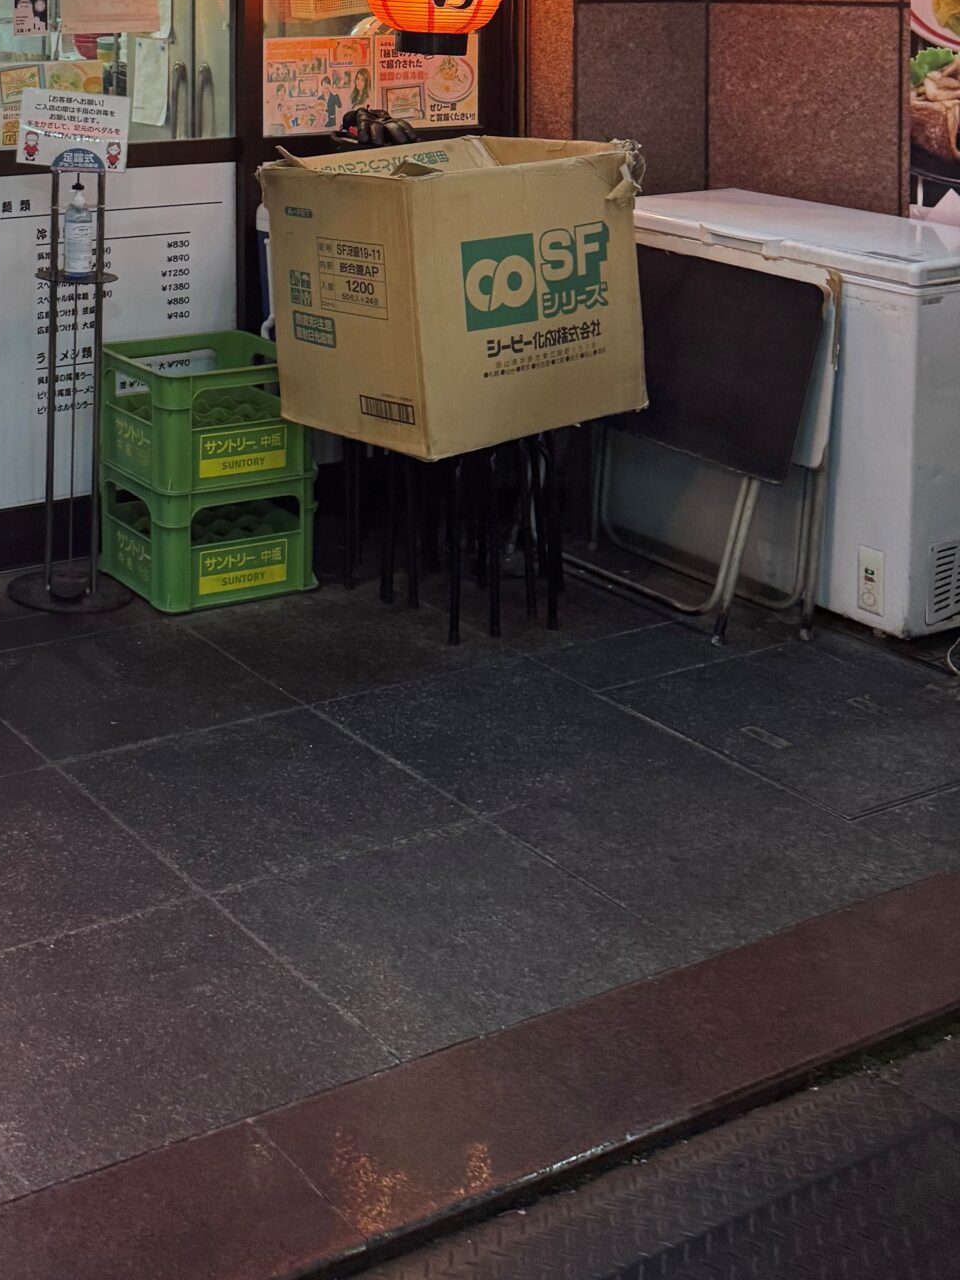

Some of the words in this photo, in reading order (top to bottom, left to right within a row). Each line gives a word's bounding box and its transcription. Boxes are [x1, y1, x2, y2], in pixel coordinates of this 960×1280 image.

[167, 240, 190, 249] ¥830
[540, 221, 610, 282] SF
[167, 254, 190, 264] ¥890
[161, 268, 190, 278] ¥1250
[161, 282, 190, 292] ¥1380
[345, 280, 375, 295] 1200
[167, 296, 190, 306] ¥880
[542, 282, 609, 319] シリーズ
[167, 310, 190, 320] ¥940
[487, 318, 601, 358] シーピー化成株式会社
[36, 346, 92, 364] ラメン類
[204, 438, 256, 455] サントリー
[260, 432, 282, 449] 中瓶
[222, 456, 266, 471] SUNTORY
[204, 553, 256, 571] サントリー
[260, 547, 282, 562] 中瓶
[222, 571, 266, 587] SUNTORY
